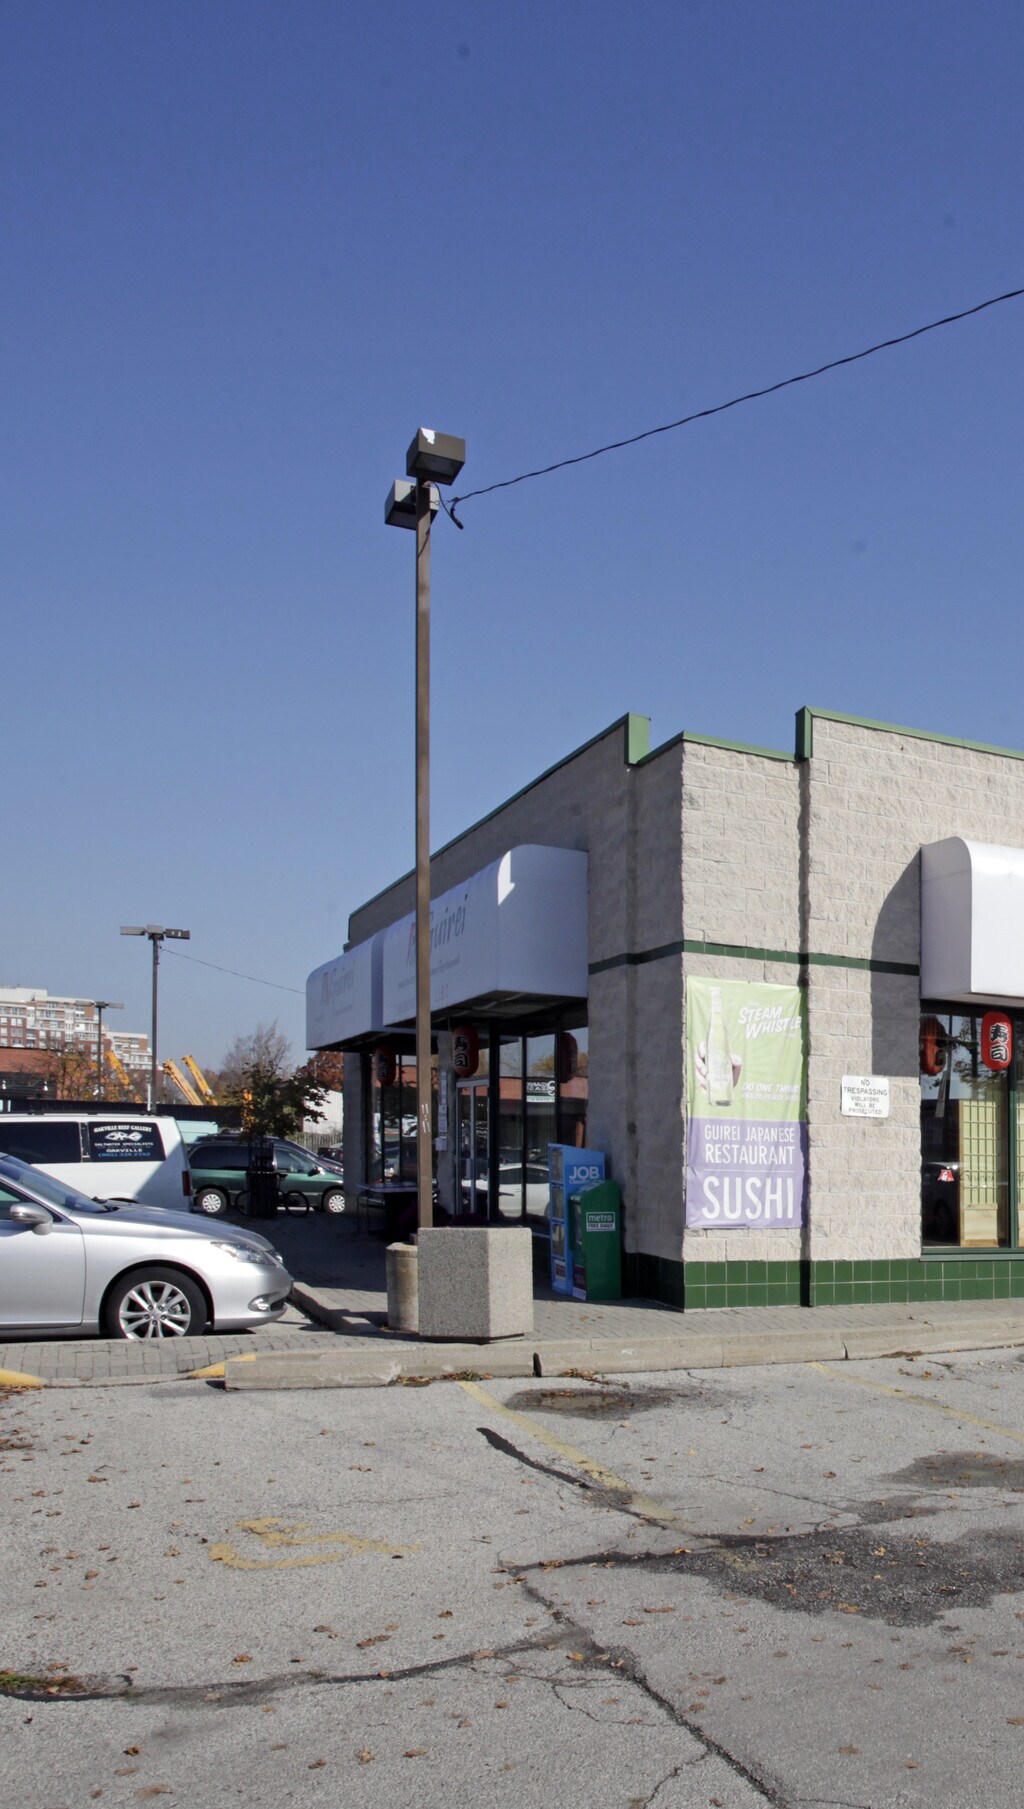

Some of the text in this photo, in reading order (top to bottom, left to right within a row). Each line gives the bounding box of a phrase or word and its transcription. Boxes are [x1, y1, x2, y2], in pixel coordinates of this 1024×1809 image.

[739, 1005, 784, 1025] STEAM
[843, 1087, 888, 1096] TRESPASSING
[860, 1079, 871, 1087] NO
[704, 1124, 796, 1143] GUIREI JAPANESE
[705, 1143, 796, 1166] RESTAURANT
[569, 1166, 600, 1180] JOB
[702, 1175, 794, 1220] SUSHI
